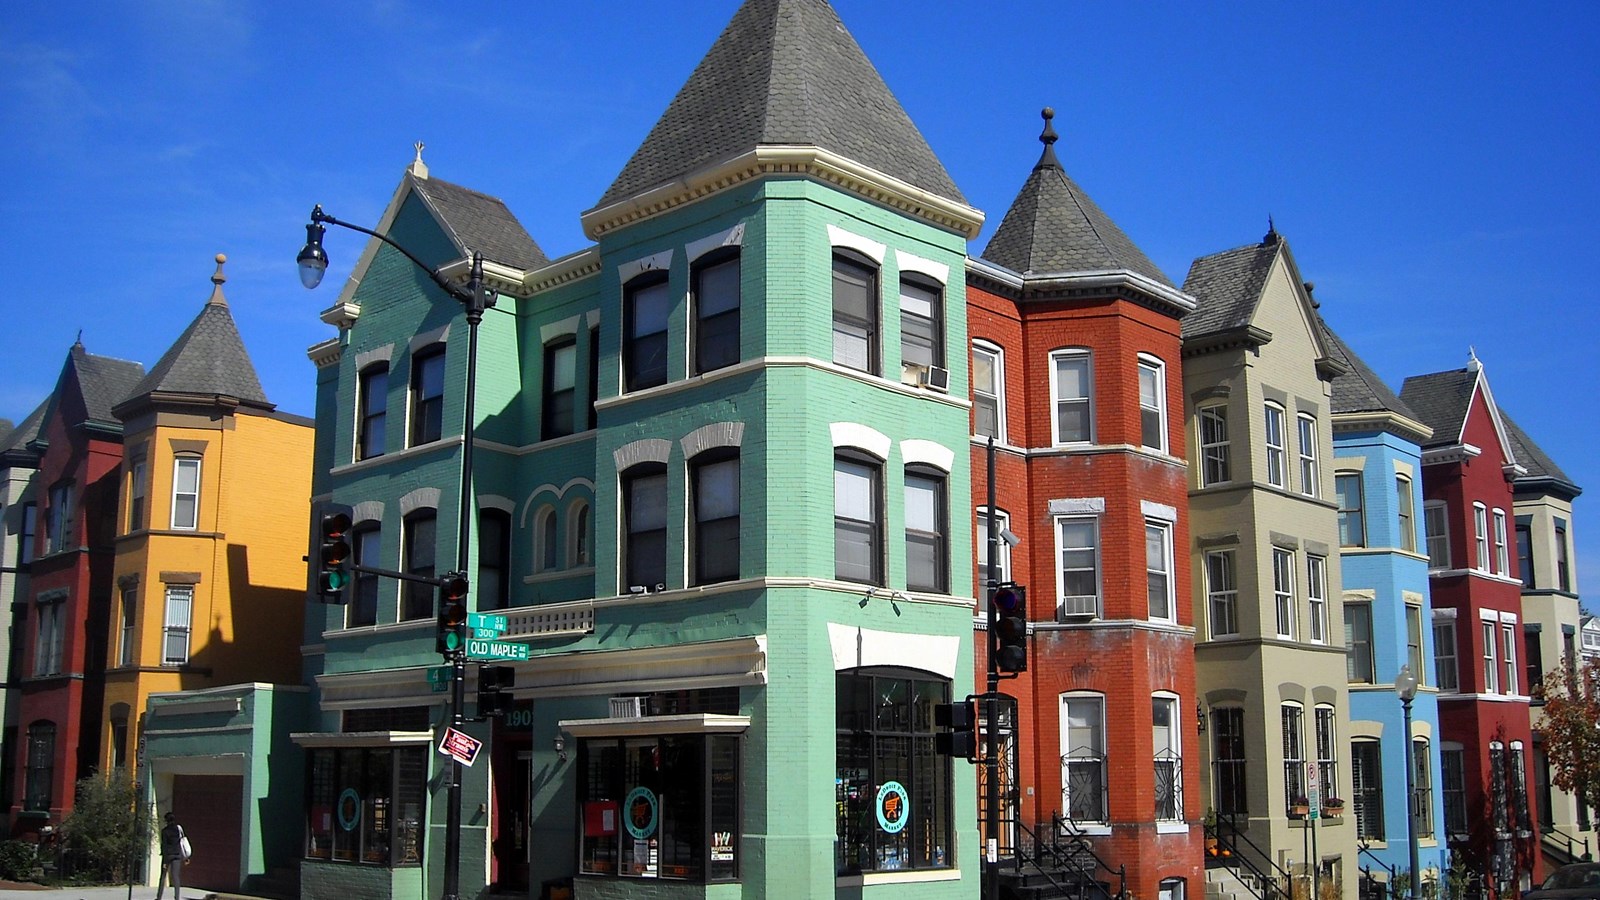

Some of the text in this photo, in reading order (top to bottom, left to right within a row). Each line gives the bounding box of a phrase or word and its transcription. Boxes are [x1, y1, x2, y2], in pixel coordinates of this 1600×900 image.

[478, 615, 503, 627] T ST
[479, 629, 494, 638] 300
[471, 641, 488, 655] OLD
[491, 644, 517, 657] MAPLE
